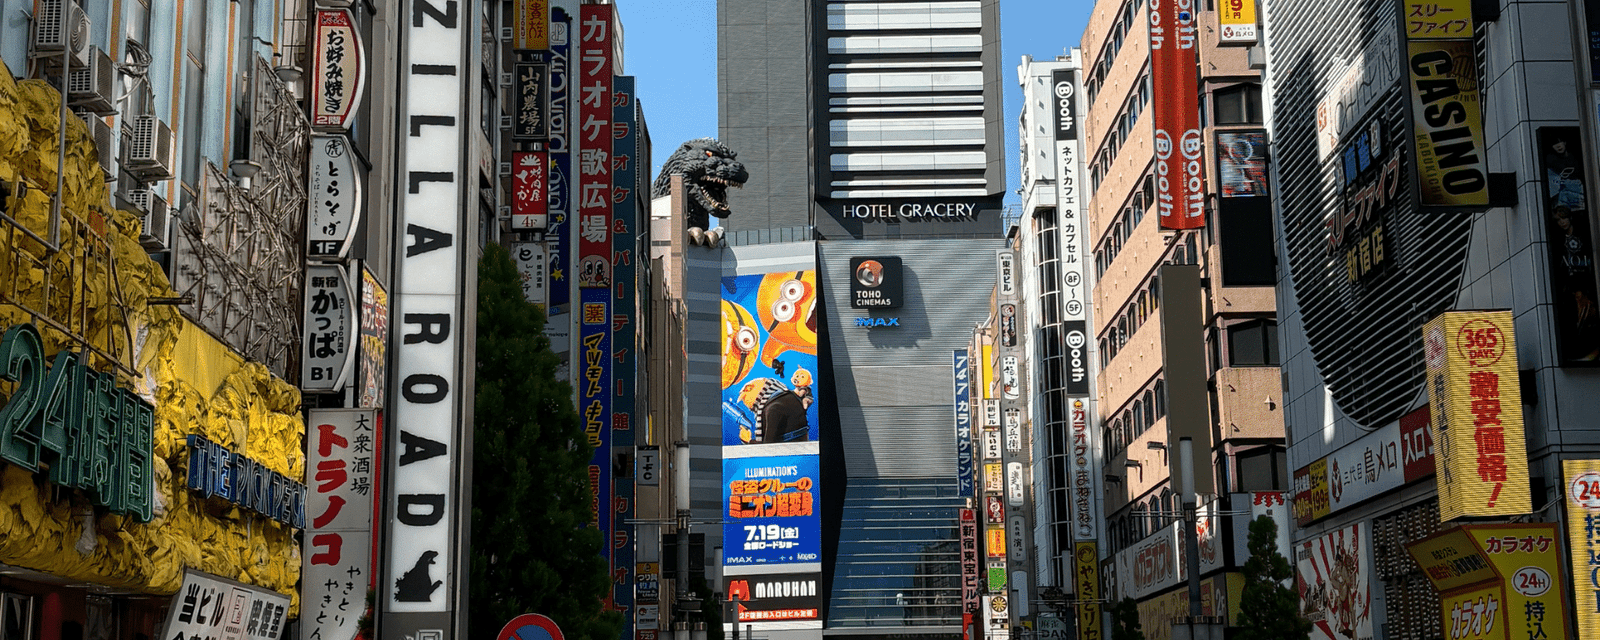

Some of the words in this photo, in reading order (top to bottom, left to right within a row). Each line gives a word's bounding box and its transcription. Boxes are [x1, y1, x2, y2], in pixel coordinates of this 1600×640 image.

[1409, 4, 1454, 17] スリー
[324, 29, 345, 113] お好み焼き
[520, 66, 541, 127] 山内農場
[1055, 81, 1074, 131] Booth
[581, 14, 608, 243] カラオケ歌広場
[1410, 49, 1486, 196] CASINO
[1062, 146, 1075, 204] ネットカフェ
[1180, 129, 1205, 218] Booth
[322, 160, 341, 236] とらそば
[842, 204, 897, 218] HOTEL
[899, 202, 976, 217] GRACERY
[1065, 209, 1075, 219] &
[521, 216, 537, 228] 4F
[1065, 223, 1077, 264] カプセル
[316, 242, 337, 253] 1F
[1347, 226, 1384, 286] 新宿店
[311, 276, 339, 288] 新宿
[856, 290, 881, 299] TOHO
[1002, 260, 1012, 292] 東京ビル
[308, 289, 339, 359] かっぱ
[585, 304, 603, 322] 薬
[856, 298, 891, 306] CINEMAS
[1066, 330, 1085, 383] Booth
[1463, 328, 1498, 349] 365
[1468, 349, 1496, 360] DAYS
[311, 367, 333, 381] B1
[0, 323, 155, 523] 24時間
[397, 313, 451, 527] ROAD
[1073, 409, 1087, 457] カラオケ
[350, 413, 373, 496] 大衆酒場
[744, 465, 798, 478] ILLUMINATION'S
[1343, 463, 1362, 487] 三代目
[1364, 440, 1398, 486] 鳥メロ
[187, 434, 232, 500] THE
[231, 452, 273, 516] PICK
[270, 470, 308, 530] PECK
[310, 424, 349, 566] トラノコ
[1075, 469, 1092, 538] まねきねこ
[1485, 535, 1553, 554] カラオケ
[755, 580, 816, 598] MARUHAN
[962, 525, 978, 613] 新宿東宝ビル店
[1103, 562, 1115, 604] 3F
[1519, 572, 1546, 589] 24H
[178, 583, 225, 628] 当ビル
[310, 579, 339, 640] やきとん
[335, 566, 362, 628] やきとり
[1450, 594, 1499, 640] カラオケ
